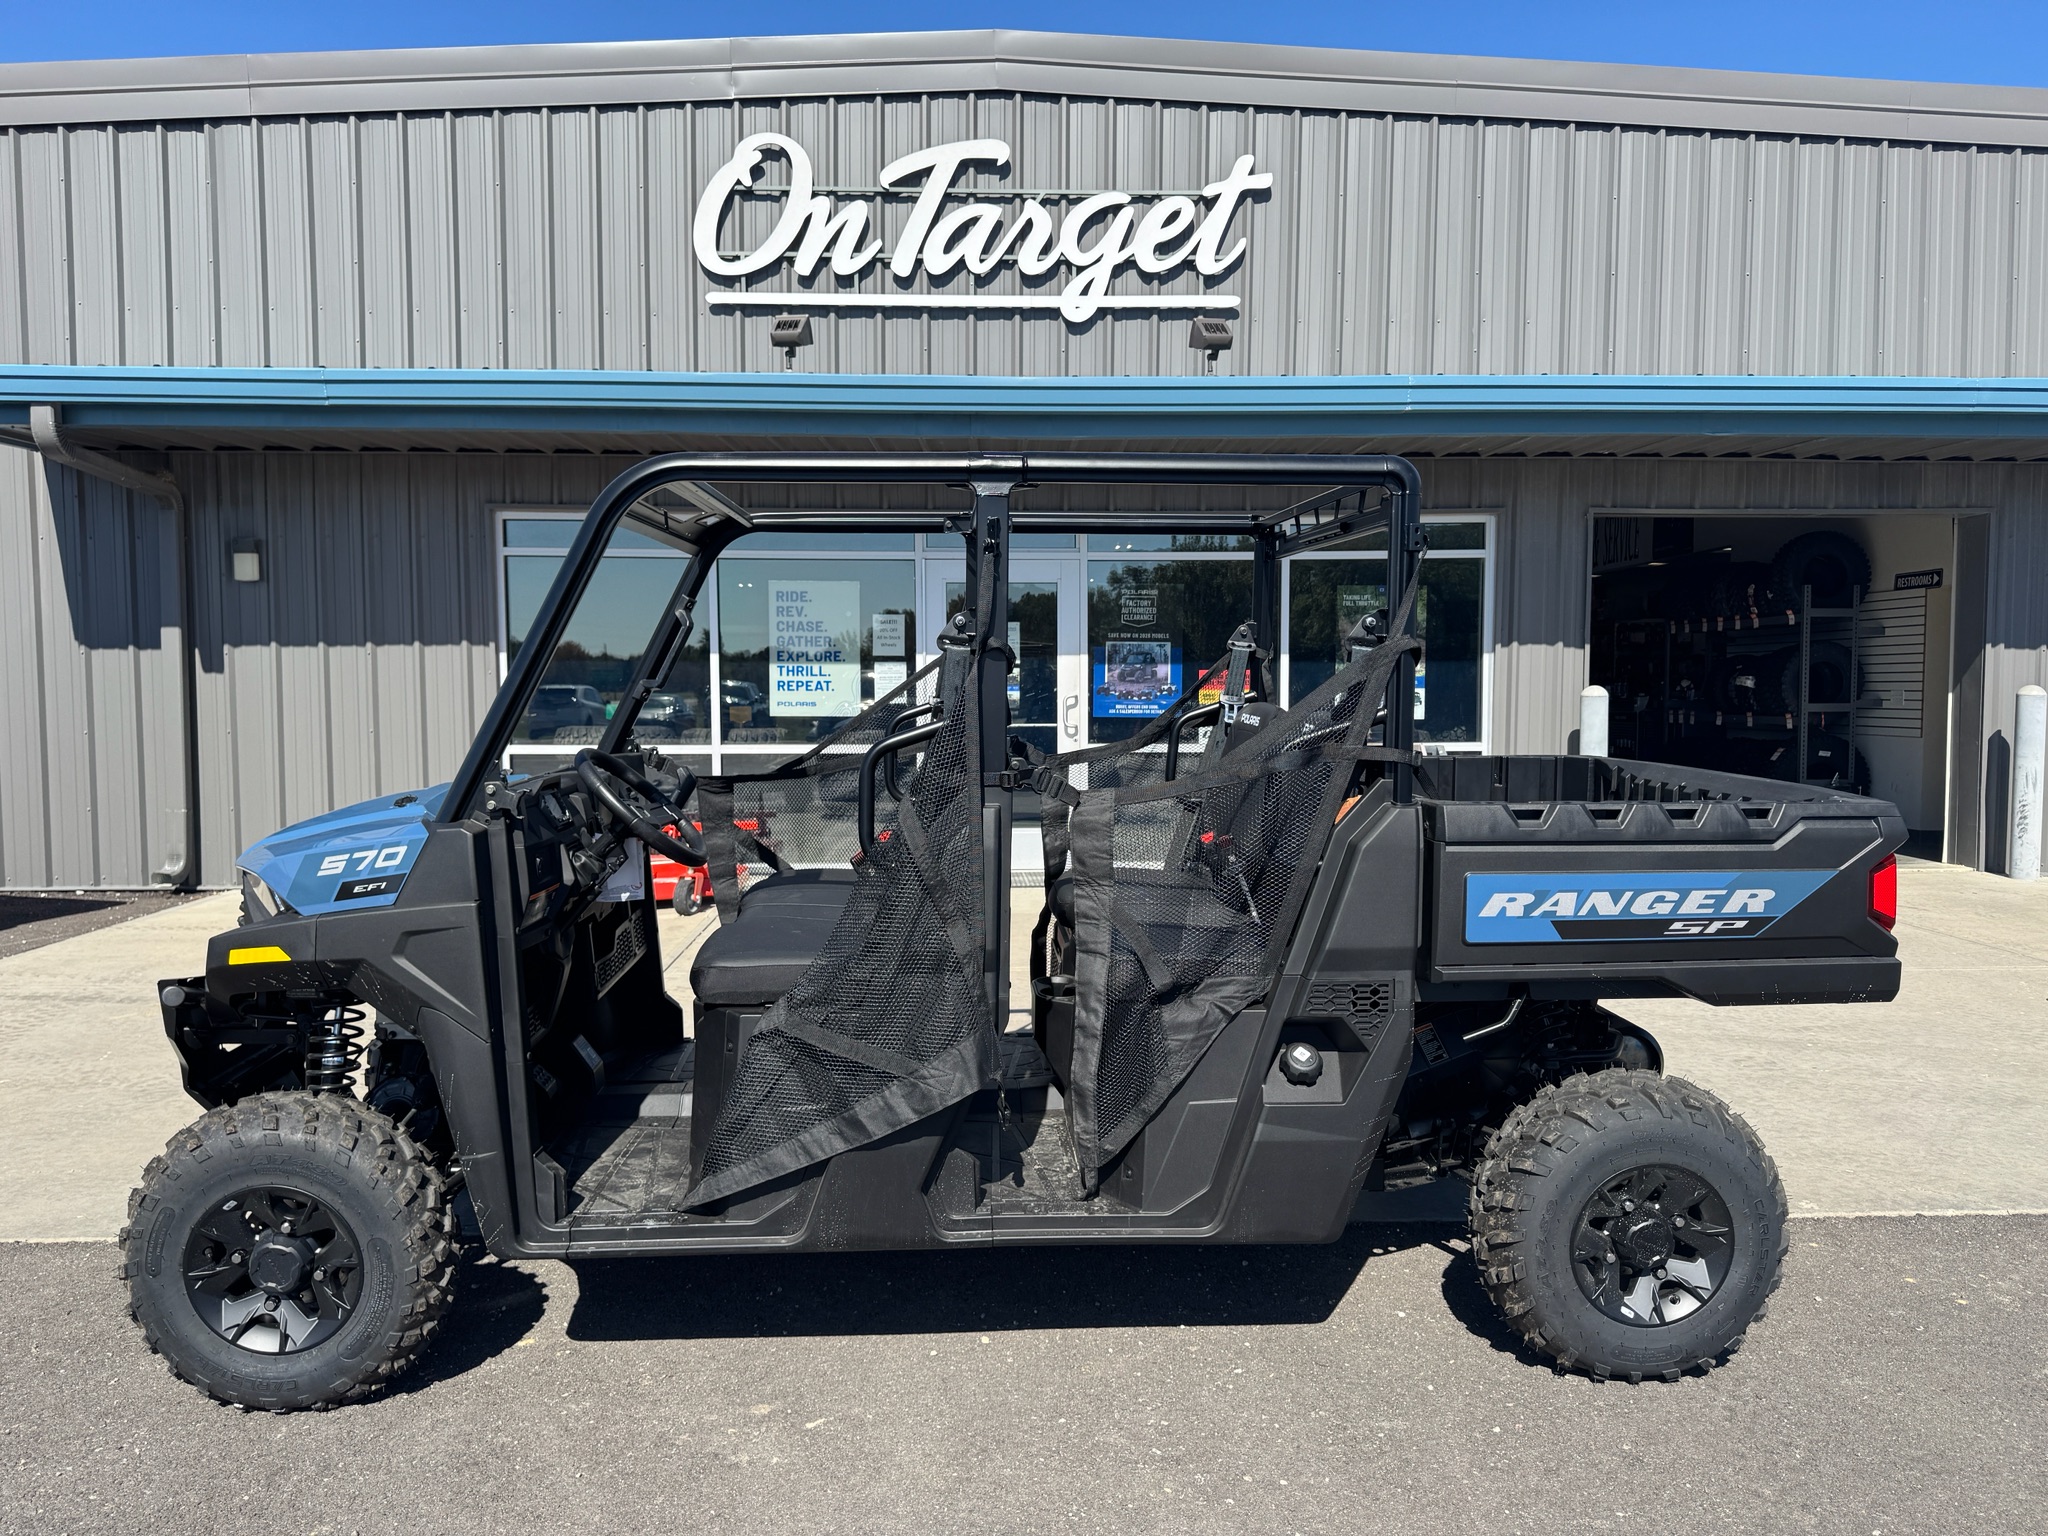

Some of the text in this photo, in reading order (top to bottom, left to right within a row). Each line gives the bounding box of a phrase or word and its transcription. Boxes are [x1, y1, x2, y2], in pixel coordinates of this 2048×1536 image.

[693, 132, 1273, 323] On Target
[1897, 574, 1933, 588] RESTROOMS
[776, 591, 812, 603] RIDE.
[776, 606, 808, 617] REV.
[776, 621, 828, 633] CHASE.
[777, 636, 837, 648] GATHER.
[777, 651, 846, 663] EXPLORE.
[777, 665, 831, 677] THRILL.
[777, 680, 835, 691] REPEAT.
[1241, 713, 1260, 727] POLARIS
[316, 845, 408, 877] 570
[353, 881, 387, 893] EFI
[1478, 889, 1776, 917] RANGER
[1663, 920, 1749, 935] SP
[1747, 1198, 1770, 1297] CARLSTAR
